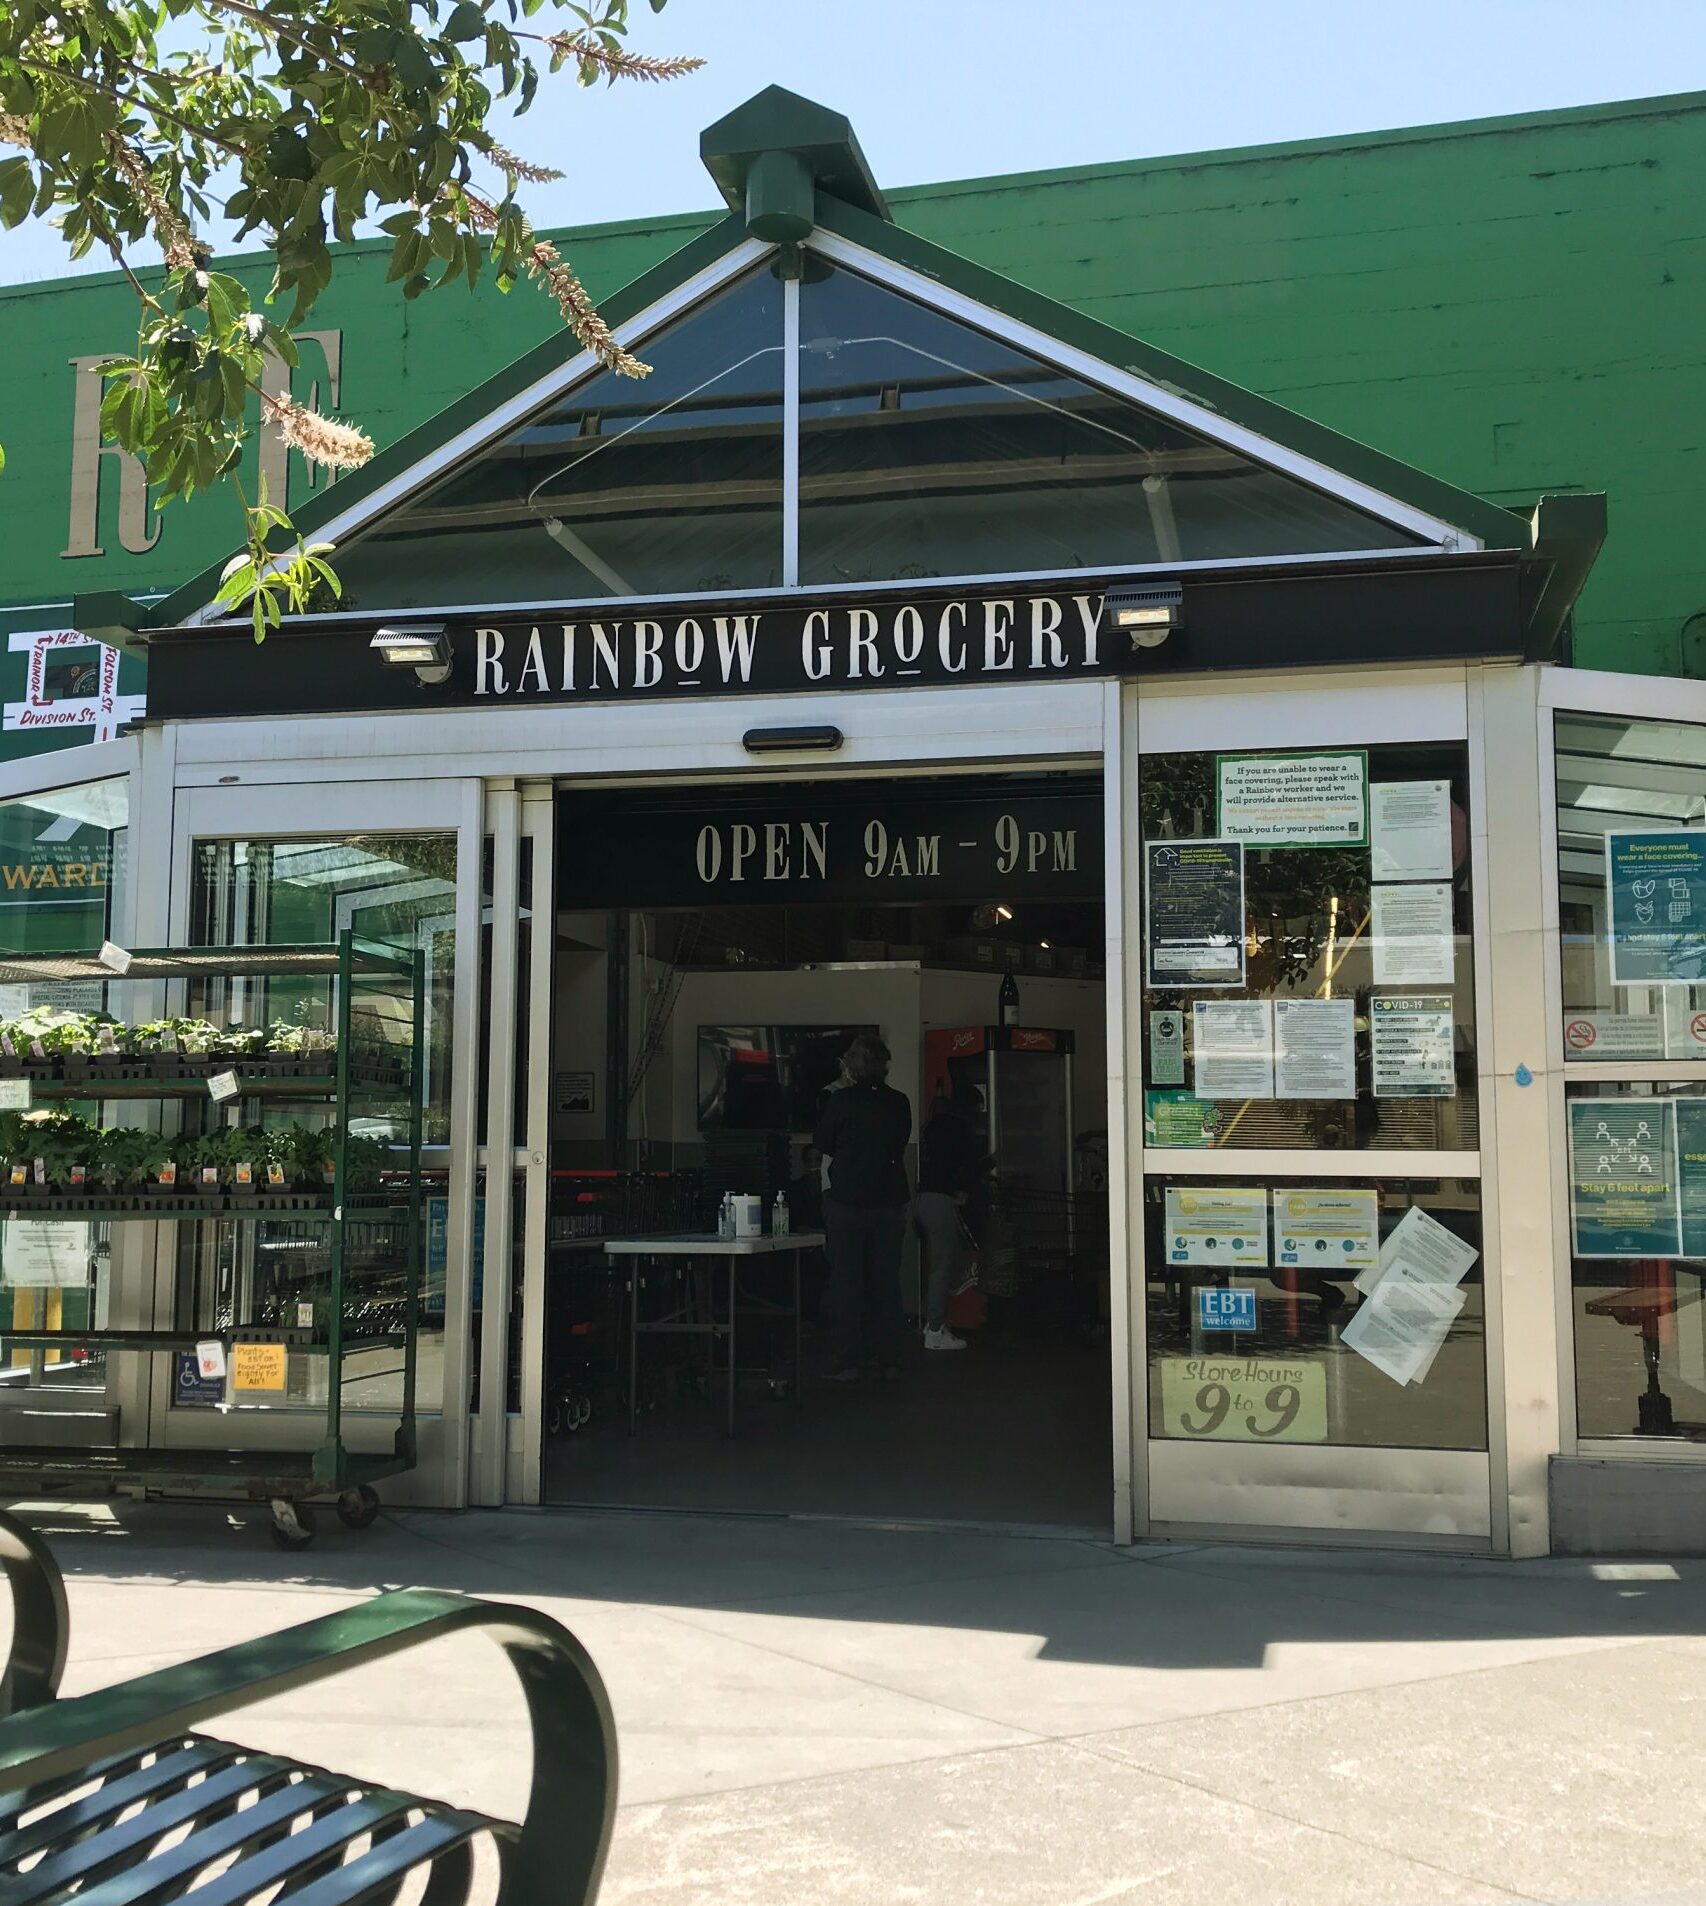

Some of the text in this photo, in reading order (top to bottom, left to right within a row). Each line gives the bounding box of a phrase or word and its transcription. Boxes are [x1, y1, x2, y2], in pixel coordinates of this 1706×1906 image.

[473, 595, 1105, 695] RAINBOW GROCERY
[31, 645, 44, 693] TRAINOR
[103, 646, 117, 695] FOLSOM
[20, 710, 77, 725] DIVISION
[1246, 768, 1261, 776] you
[1278, 765, 1307, 773] unable
[1245, 776, 1283, 784] covering,
[1285, 775, 1312, 784] please
[1246, 786, 1282, 794] Rainbow
[1284, 785, 1314, 793] worker
[1243, 796, 1276, 805] provide
[1277, 795, 1323, 803] alternative
[1227, 826, 1253, 834] Thank
[1272, 825, 1285, 833] for
[1287, 826, 1307, 834] your
[1309, 824, 1347, 832] patience.
[695, 821, 830, 883] OPEN
[864, 819, 941, 878] 9AM
[995, 814, 1078, 874] 9PM
[1630, 844, 1668, 852] Everyone
[1581, 1183, 1670, 1194] Stay 6 feet apart
[1205, 1292, 1252, 1314] EBT
[1206, 1316, 1250, 1325] welcome
[1182, 1360, 1303, 1383] Store Hours
[1180, 1383, 1300, 1437] 9 to 9
